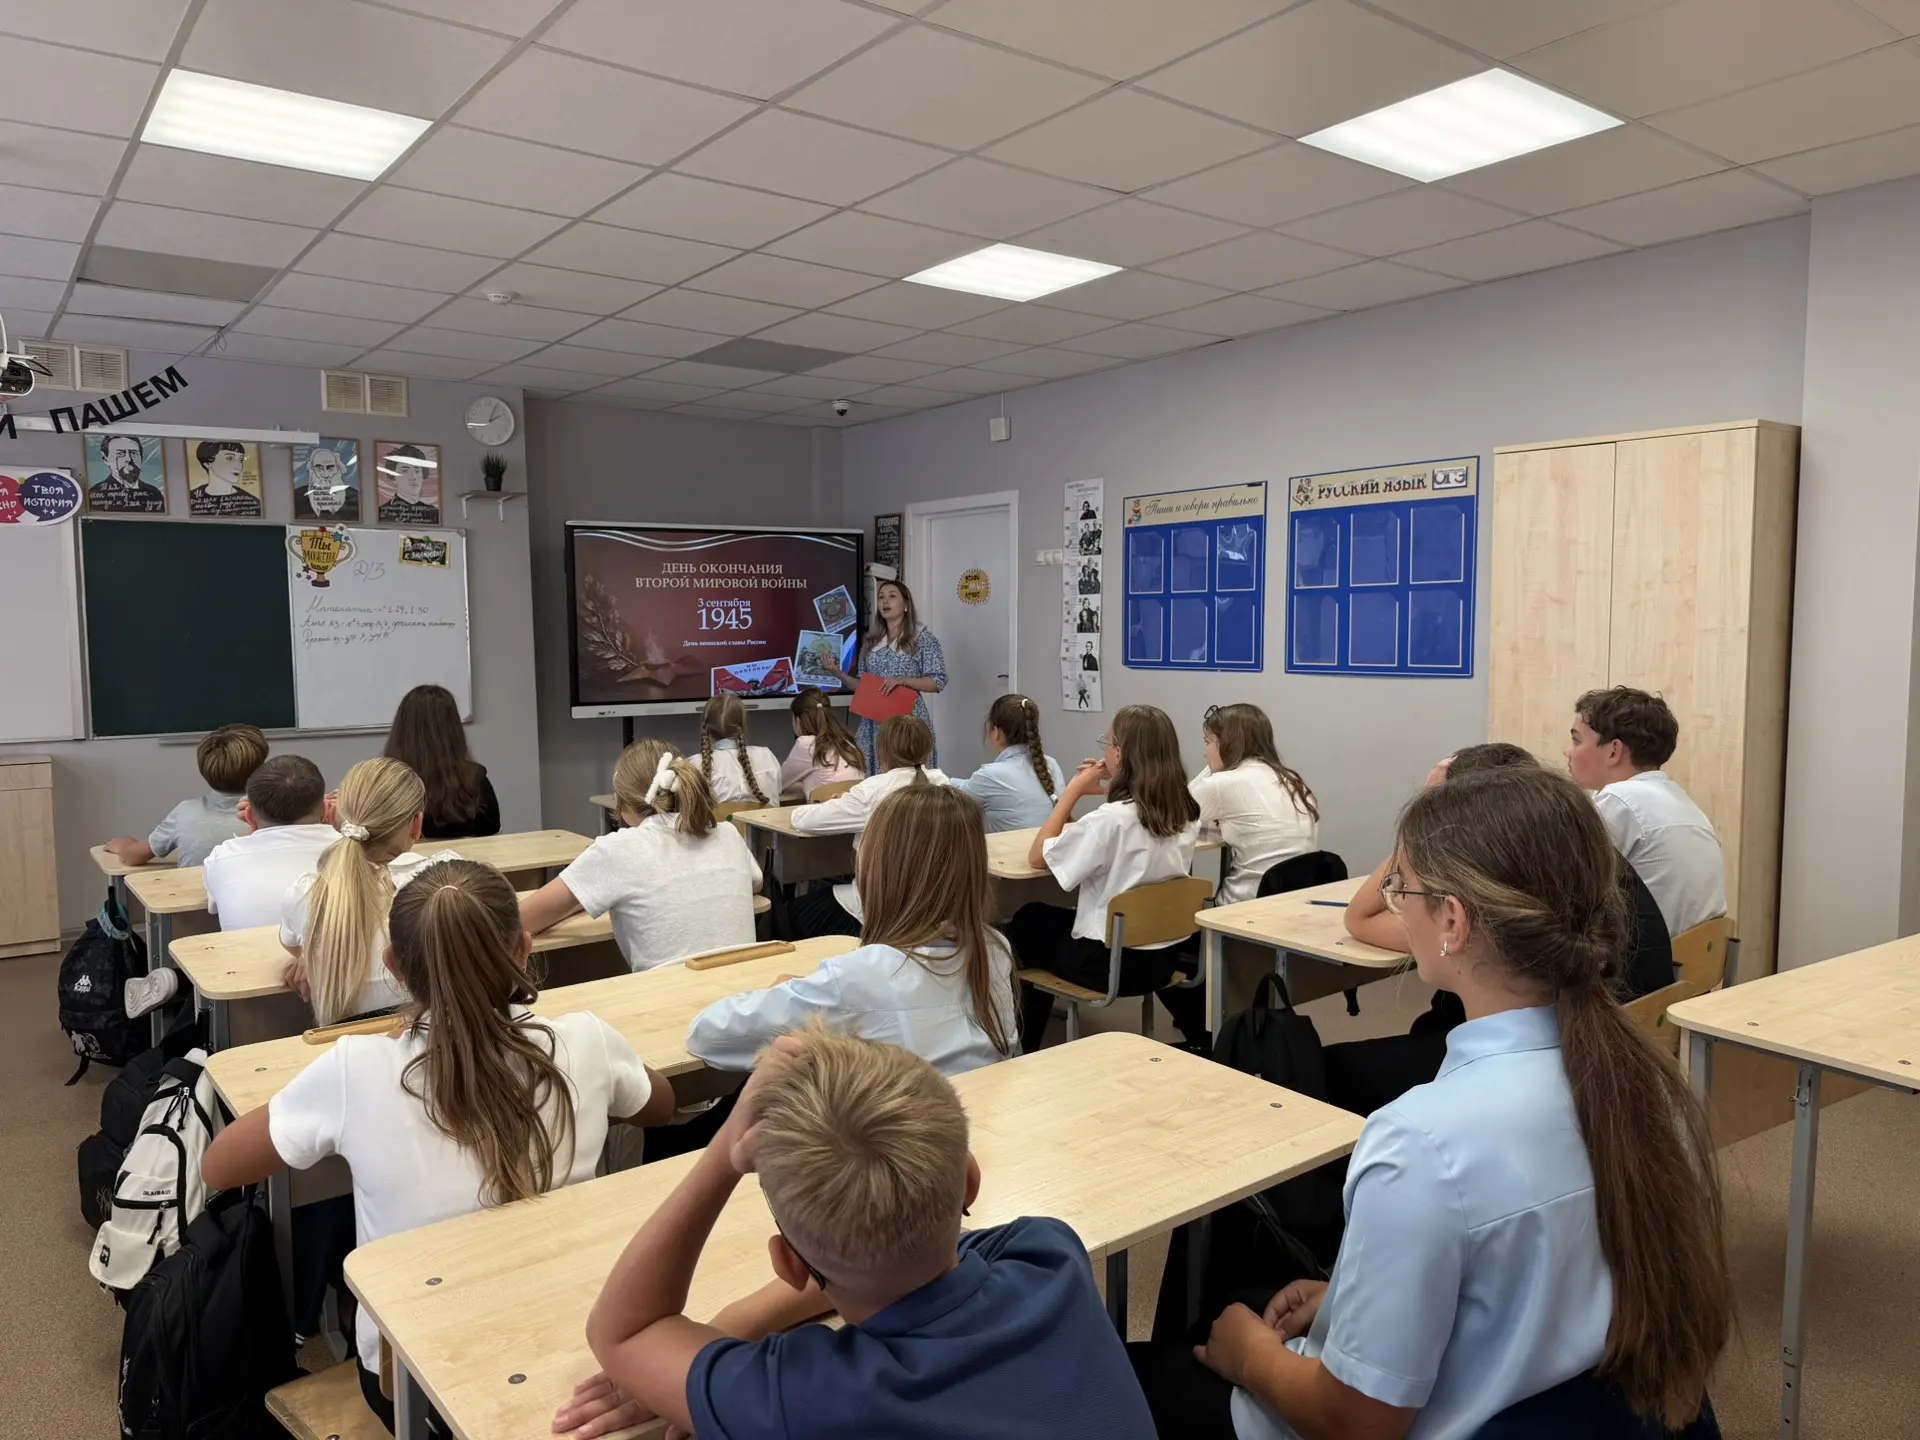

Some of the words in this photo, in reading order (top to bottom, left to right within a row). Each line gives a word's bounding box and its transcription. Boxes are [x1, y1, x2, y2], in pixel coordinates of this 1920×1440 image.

[49, 365, 189, 434] ПАШЕМ
[32, 485, 64, 495] ТВОЯ
[1317, 479, 1380, 499] РУССКИЙ
[1383, 475, 1427, 493] ЯЗЫК
[1433, 469, 1466, 485] ОГЭ
[23, 498, 73, 508] ИСТОРИЯ
[1144, 499, 1173, 515] Пиши
[1211, 492, 1259, 513] правильно
[309, 537, 332, 551] Ты
[662, 563, 697, 575] ДЕНЬ
[700, 563, 783, 575] ОКОНЧАНИЯ
[635, 575, 690, 588] ВТОРОЙ
[693, 576, 758, 589] МИРОВОЙ
[761, 576, 807, 589] ВОЙНЫ
[698, 598, 704, 608] 3
[706, 598, 751, 611] сентября
[696, 607, 753, 630] 1945
